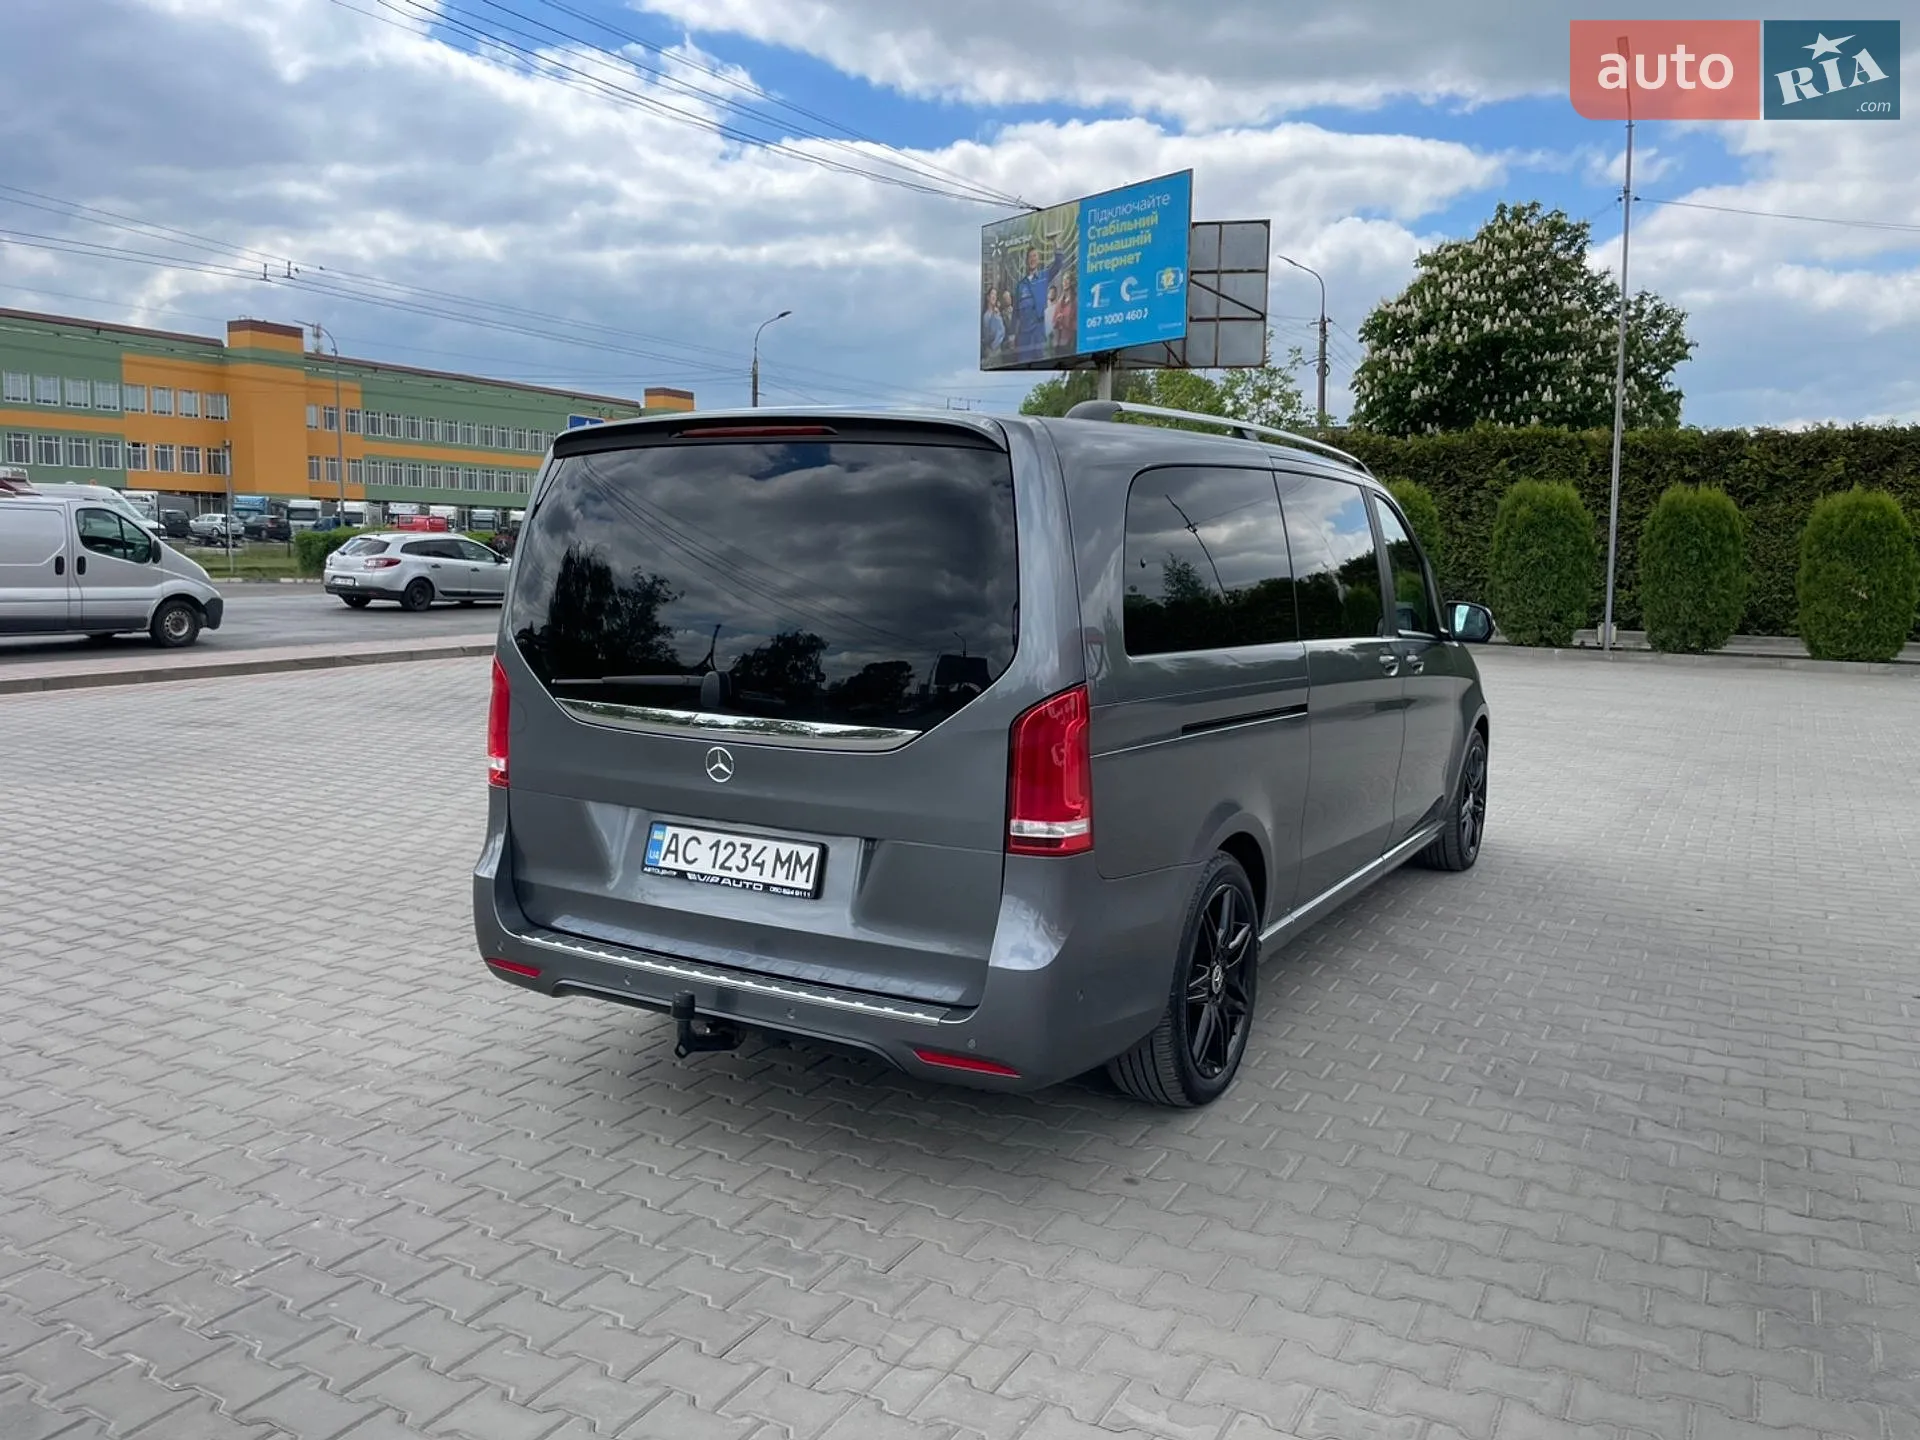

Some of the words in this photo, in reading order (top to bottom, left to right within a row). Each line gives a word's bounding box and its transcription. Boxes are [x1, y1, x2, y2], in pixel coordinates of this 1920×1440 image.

[1088, 193, 1171, 224] Підключайте
[1087, 210, 1159, 240] Стабільний
[1087, 229, 1152, 258] Домашній
[1086, 315, 1102, 328] 067
[1103, 311, 1124, 325] 1000
[662, 833, 702, 865] AC
[709, 839, 768, 876] 1234
[771, 848, 815, 883] MM
[720, 878, 764, 891] AUTO
